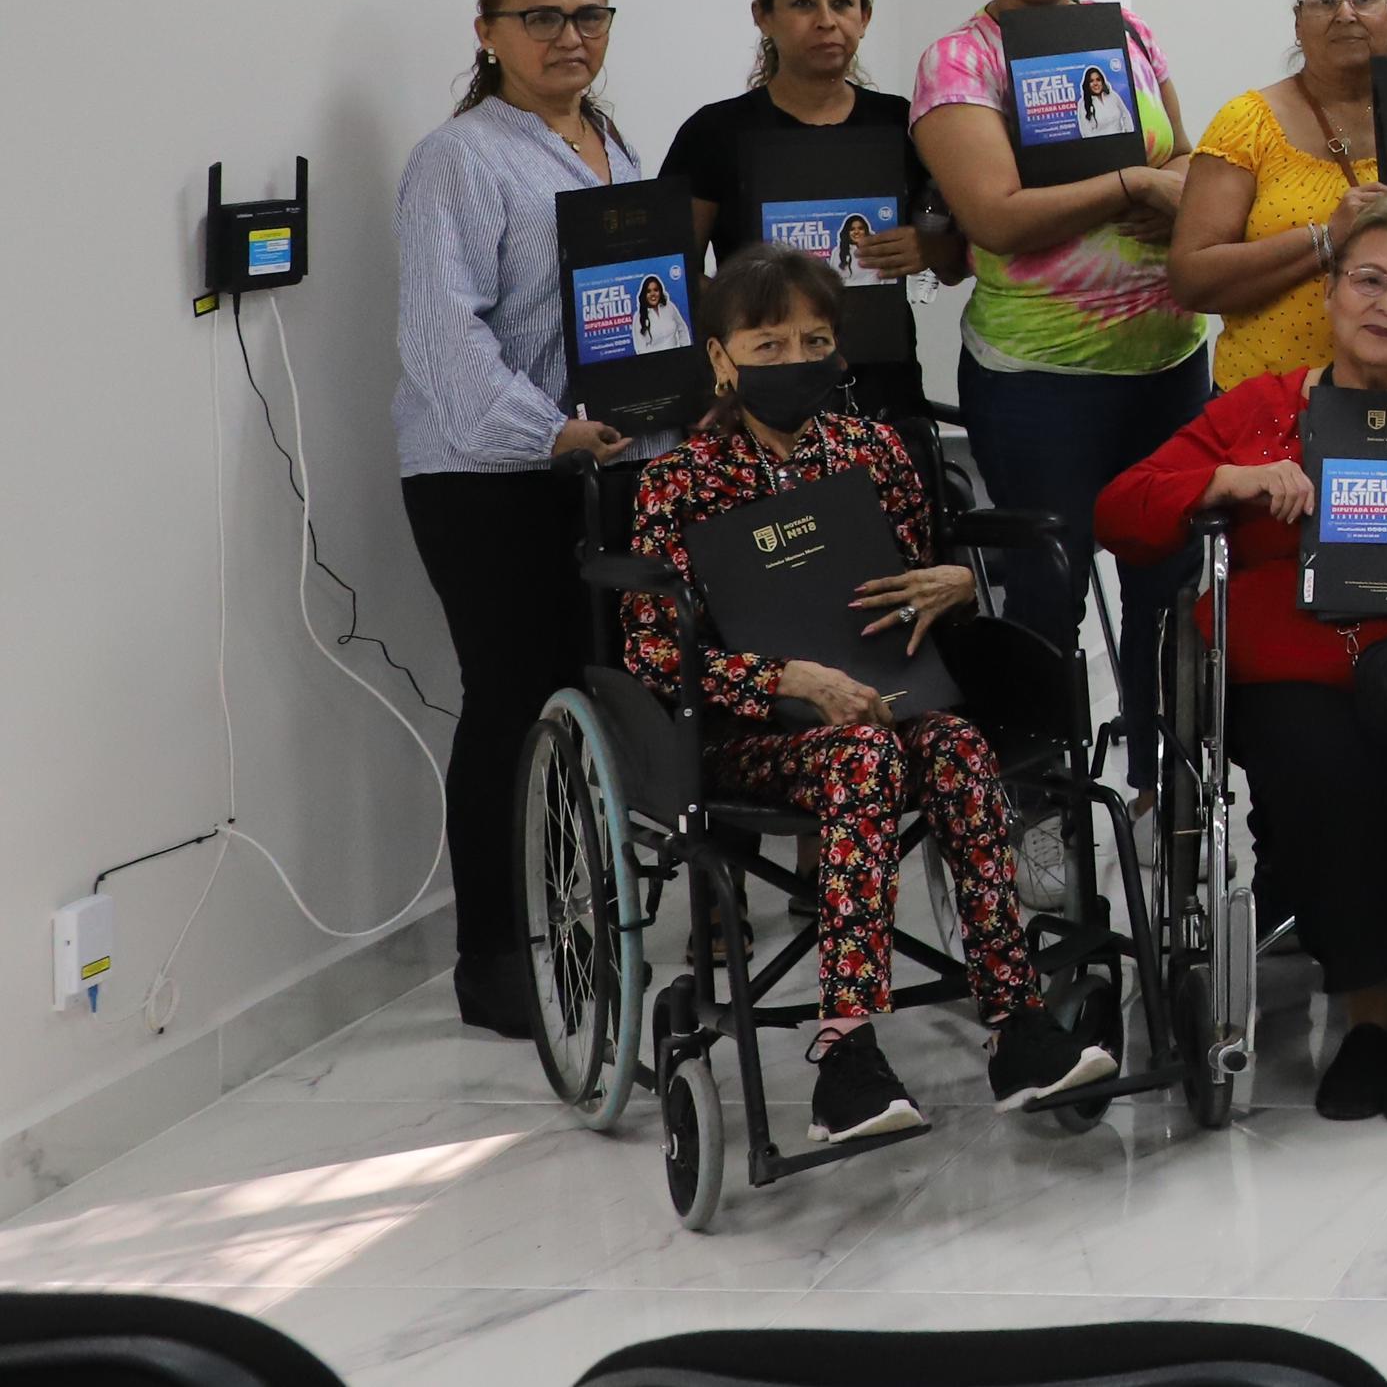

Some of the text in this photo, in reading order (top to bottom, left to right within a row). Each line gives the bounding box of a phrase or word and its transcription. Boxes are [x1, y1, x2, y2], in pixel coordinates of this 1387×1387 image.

[1022, 75, 1074, 93] ITZEL
[1024, 88, 1076, 108] CASTILLO
[771, 221, 830, 237] ITZEL
[581, 285, 630, 305] ITZEL
[583, 299, 632, 321] CASTILLO
